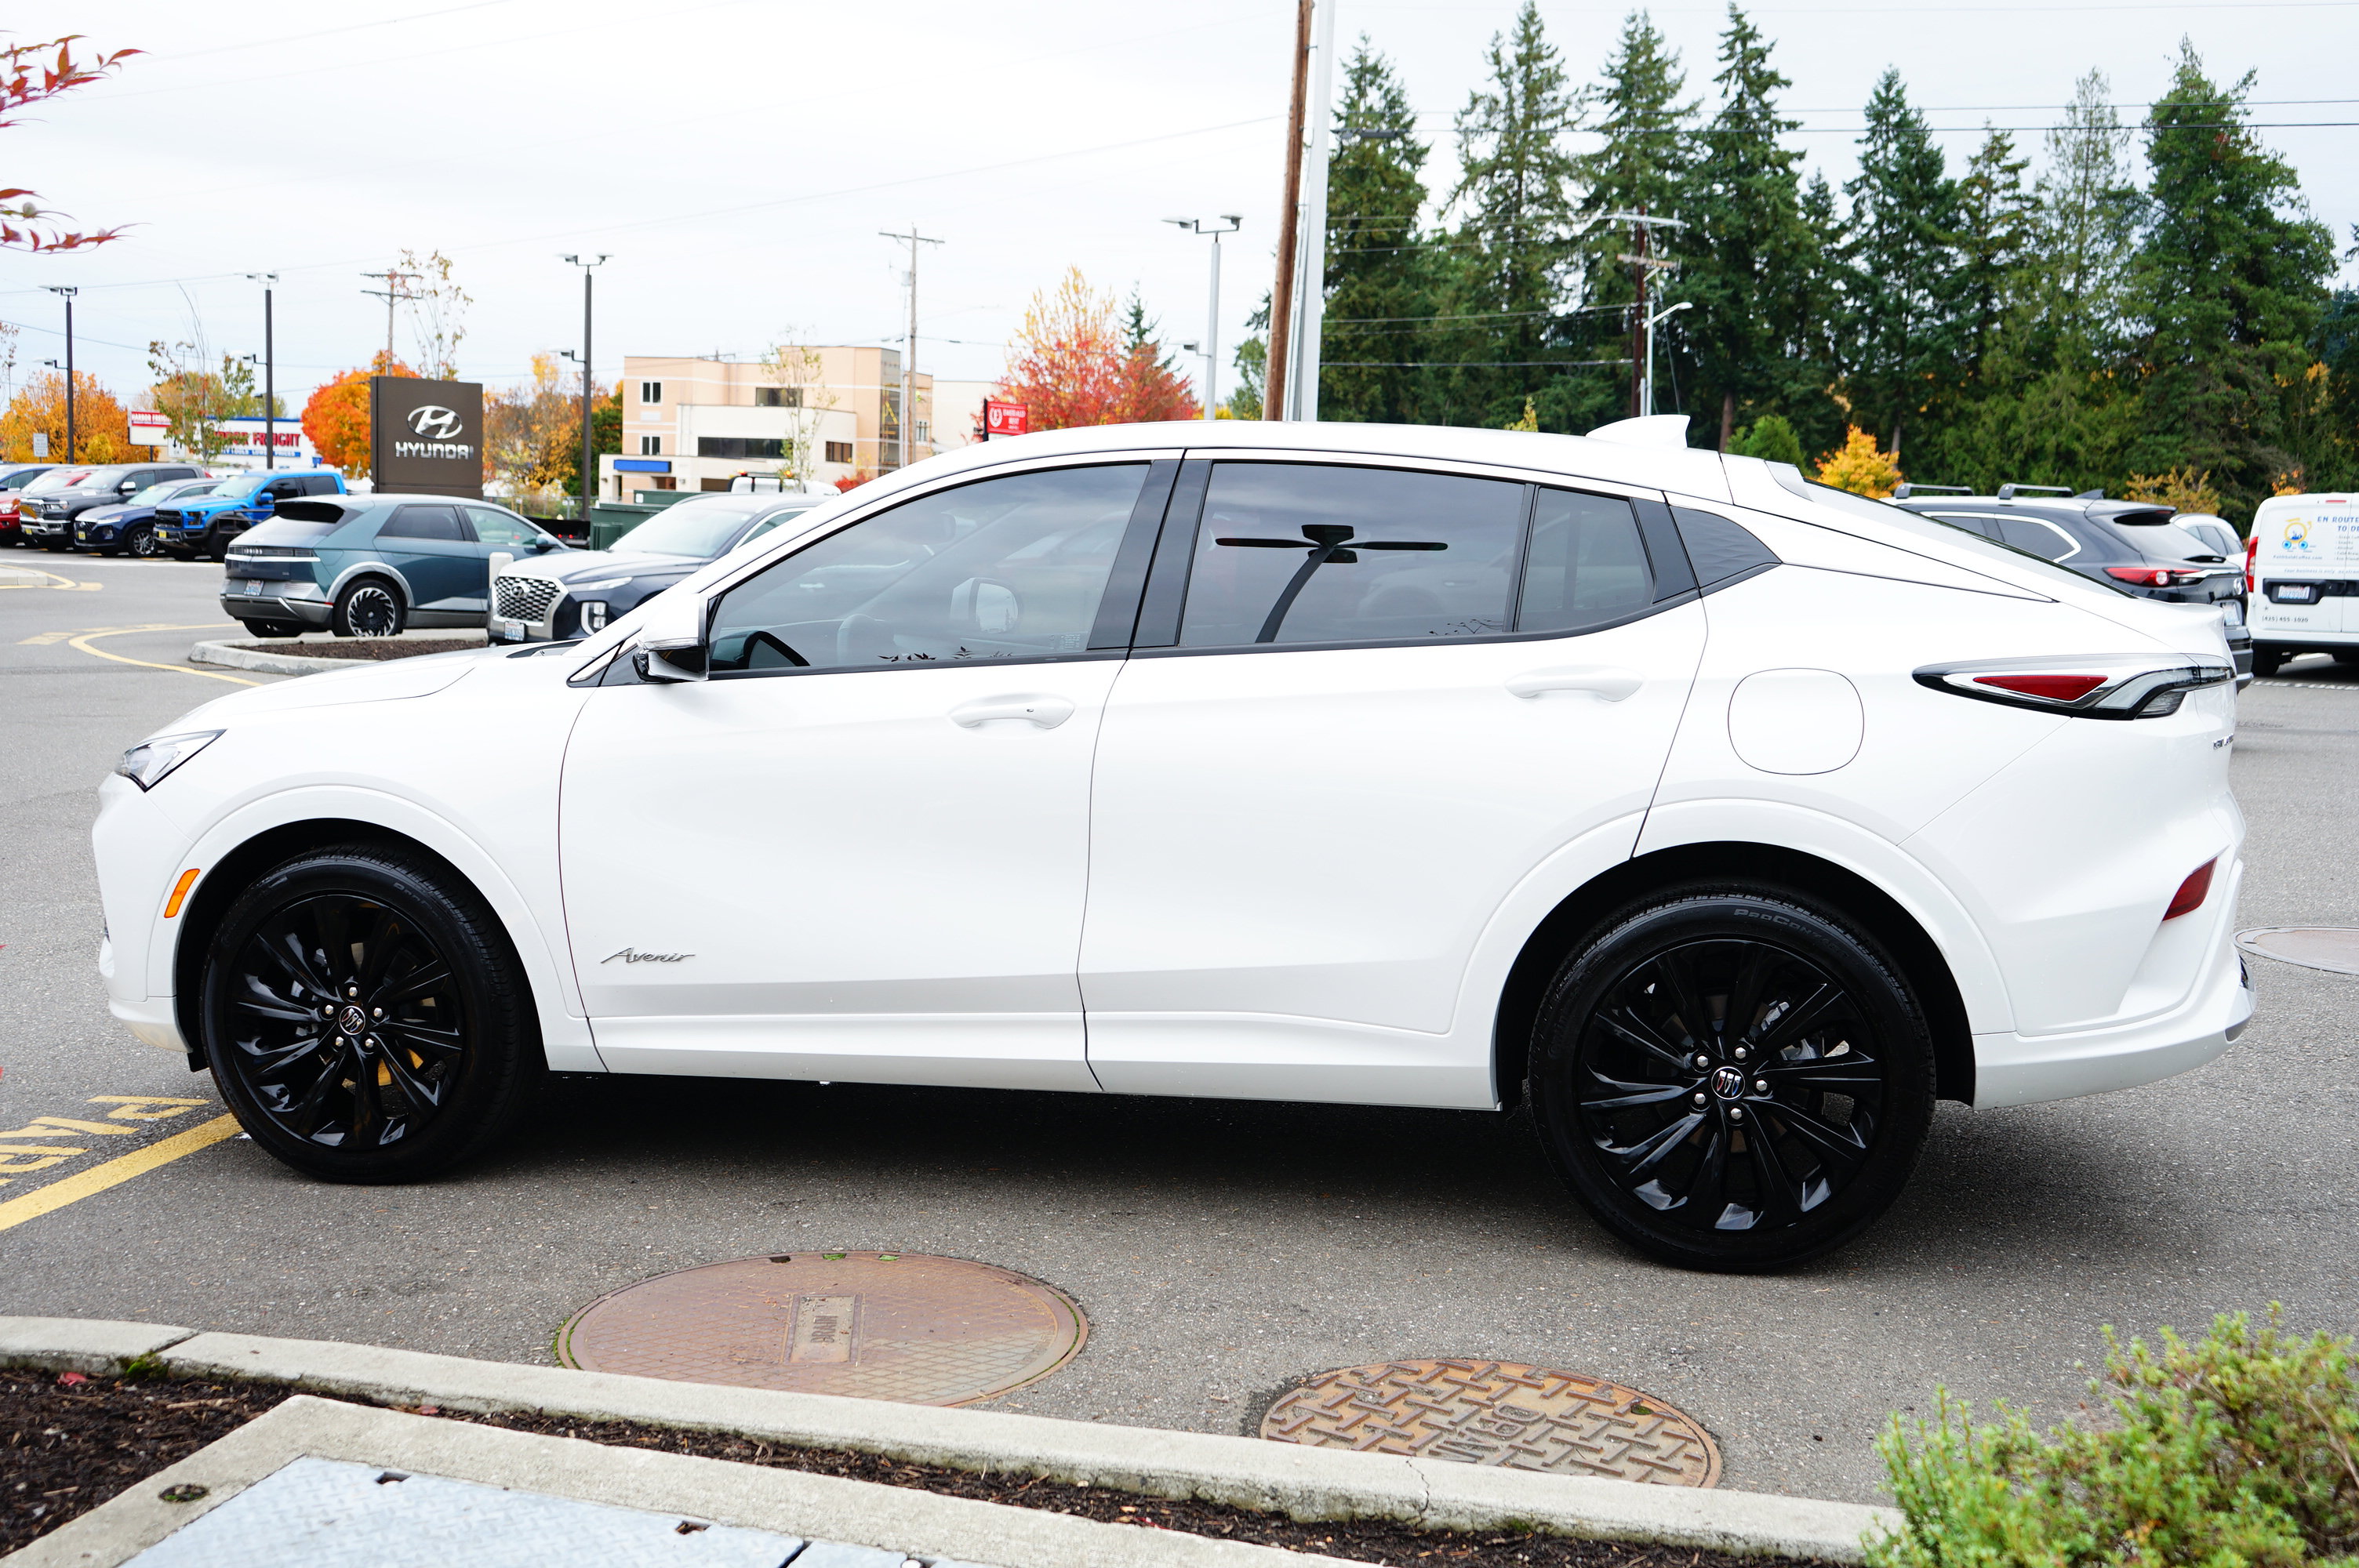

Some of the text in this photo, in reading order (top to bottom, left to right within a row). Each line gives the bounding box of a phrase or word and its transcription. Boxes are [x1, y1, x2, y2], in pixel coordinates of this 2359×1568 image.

[253, 432, 300, 446] FRIGHT
[395, 441, 474, 459] HYUNDAI
[600, 946, 696, 964] Avenir
